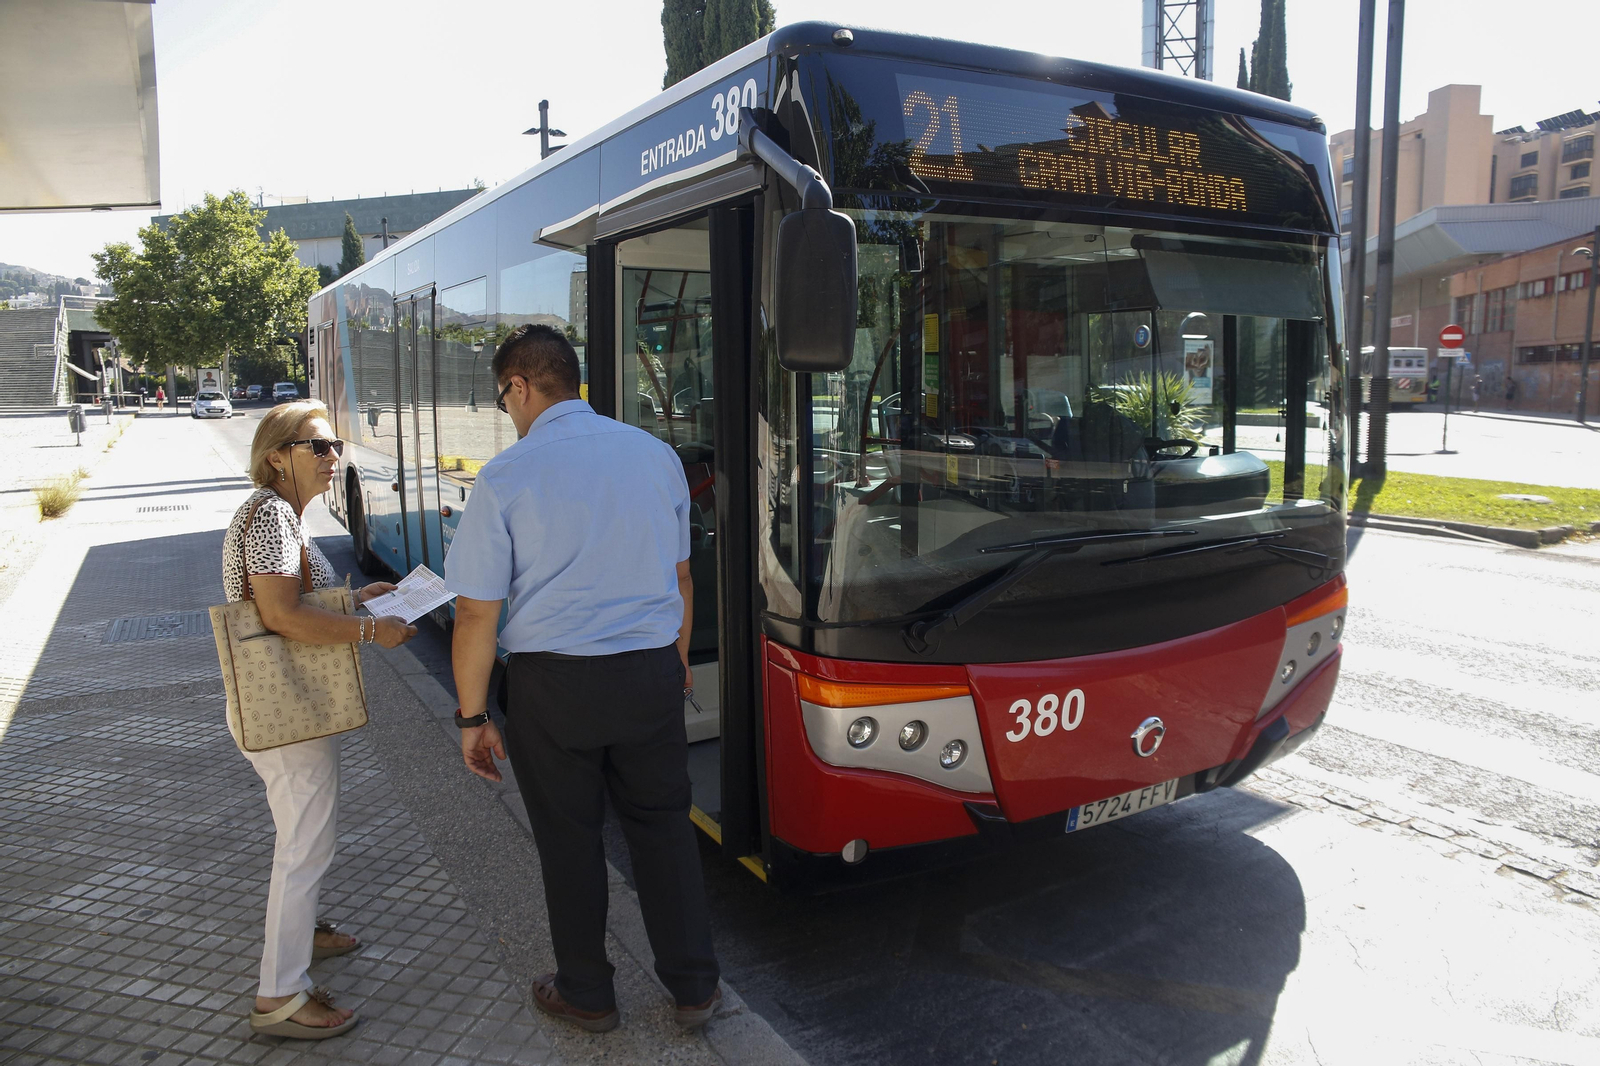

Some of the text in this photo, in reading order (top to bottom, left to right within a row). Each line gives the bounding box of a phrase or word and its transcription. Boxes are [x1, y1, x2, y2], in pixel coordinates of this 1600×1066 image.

[641, 78, 757, 176] ENTRADA 380
[903, 91, 974, 182] 21
[1066, 114, 1202, 168] CIRCULAR
[1018, 149, 1247, 212] GRAN VIA-RONDA
[1005, 688, 1086, 743] 380
[1083, 779, 1176, 825] 5724 FFV
